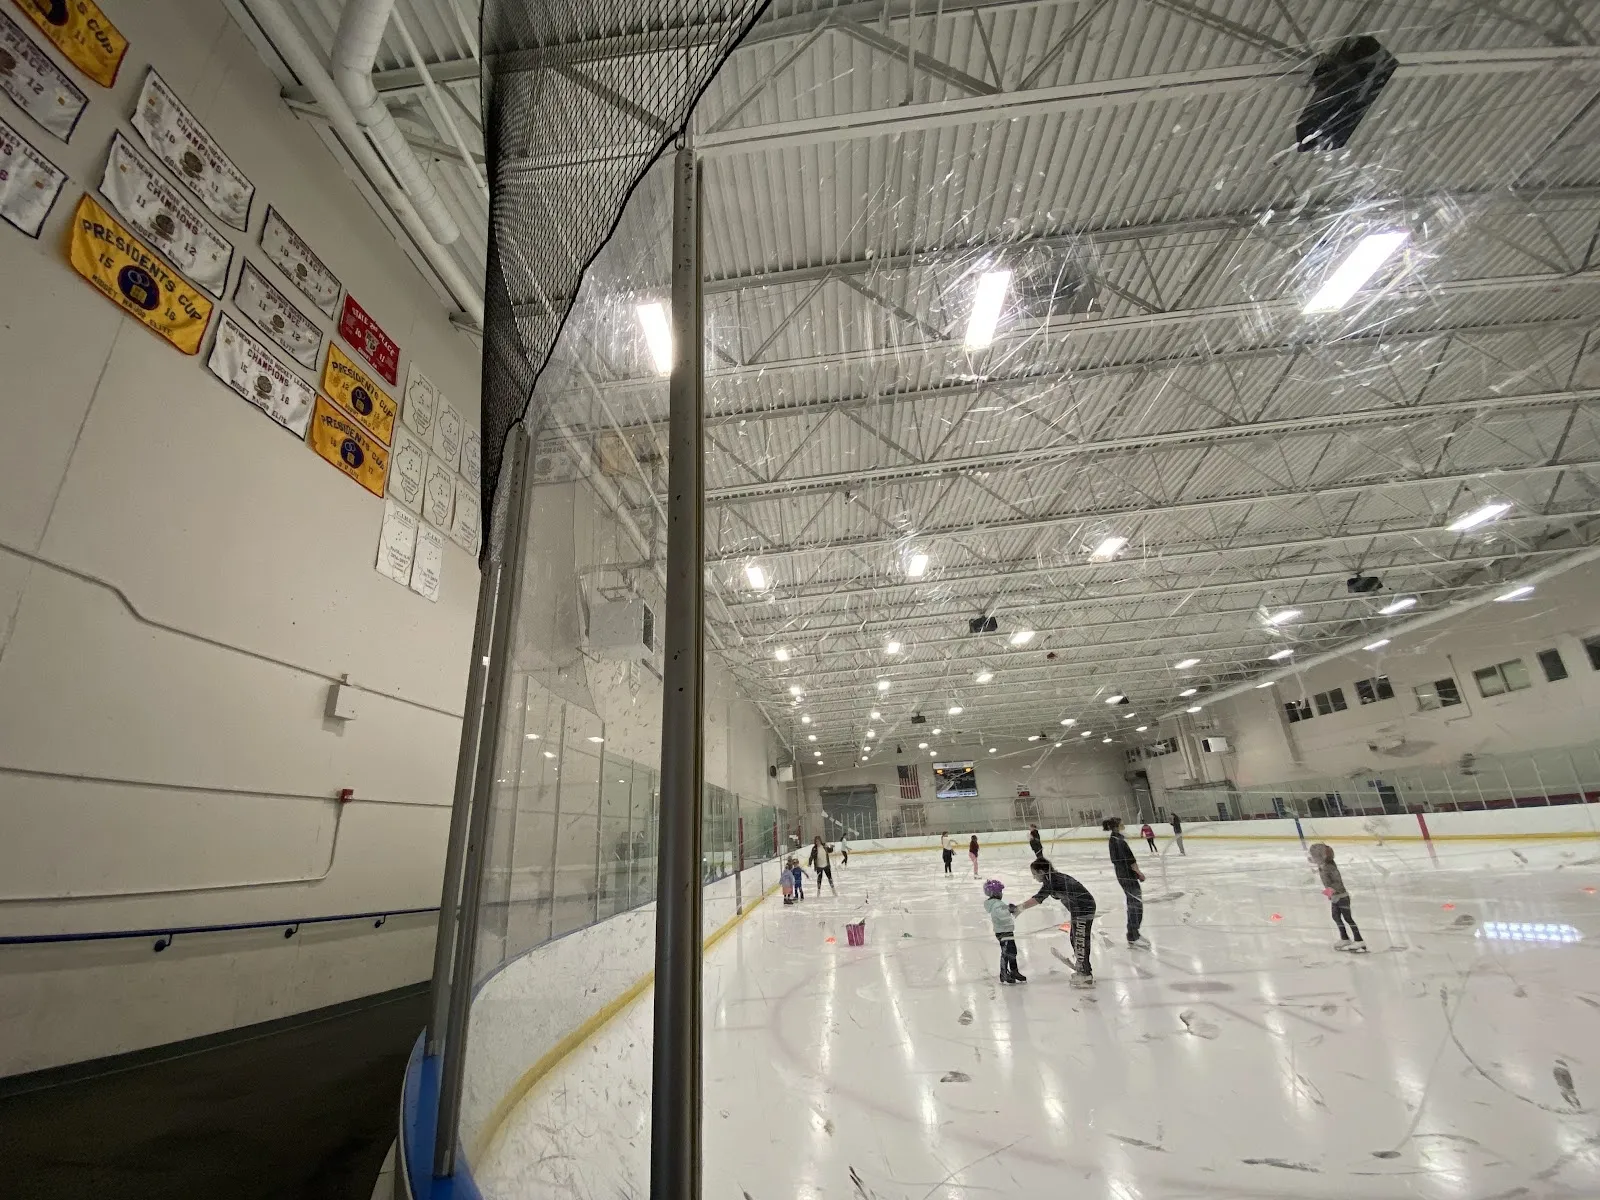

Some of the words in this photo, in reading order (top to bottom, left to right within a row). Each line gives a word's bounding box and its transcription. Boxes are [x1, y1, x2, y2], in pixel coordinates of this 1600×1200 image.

[87, 18, 113, 54] CUP
[5, 32, 46, 77] PLACE
[27, 77, 45, 95] 12
[164, 129, 176, 144] 10
[120, 143, 154, 180] NORTHERN
[204, 227, 227, 252] LEAGUE
[136, 194, 146, 209] 11
[146, 181, 199, 236] CHAMPIONS
[130, 219, 158, 244] MIDGET
[98, 252, 115, 269] 15
[184, 242, 197, 257] 12
[300, 249, 322, 276] PLACE
[82, 219, 177, 293] PRESIDENTS
[178, 294, 203, 321] CUP
[91, 273, 119, 299] MIDGET
[121, 298, 147, 320] MAJOR
[278, 302, 301, 328] PLACE
[291, 330, 301, 342] 12
[378, 332, 396, 357] PLACE
[247, 348, 290, 388] CHAMPIONS
[293, 378, 312, 394] LEAGUE
[331, 361, 379, 398] PRESIDENTS
[379, 399, 394, 418] CUP
[230, 379, 250, 397] MIDGET
[271, 410, 288, 425] ELITE
[320, 415, 371, 453] PRESIDENTS
